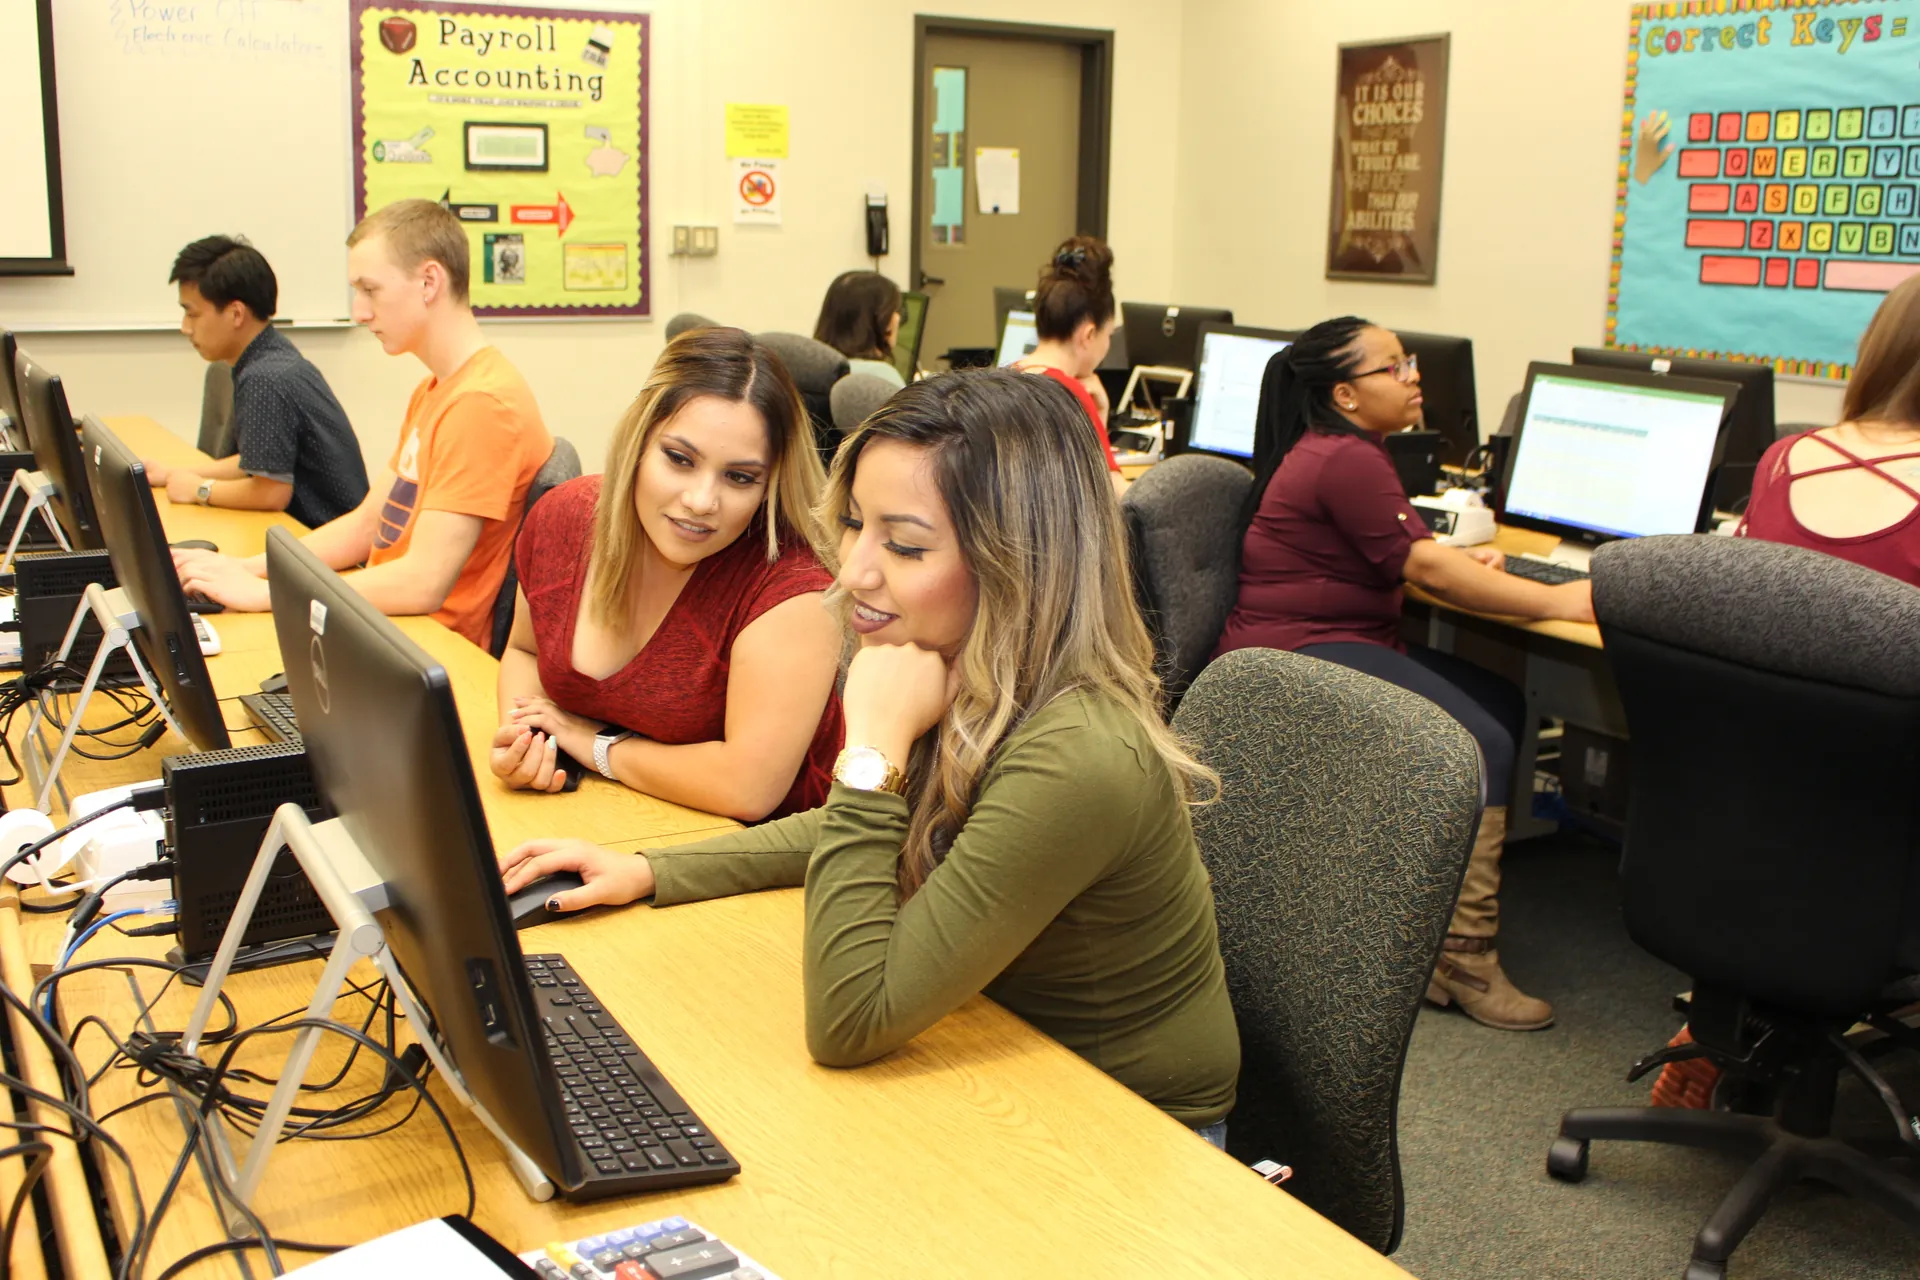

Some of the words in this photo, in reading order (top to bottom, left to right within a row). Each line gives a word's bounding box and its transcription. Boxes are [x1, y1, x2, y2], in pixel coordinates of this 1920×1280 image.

[439, 19, 556, 56] Payroll
[1645, 15, 1772, 57] Correct
[1791, 12, 1882, 55] Keys
[408, 58, 604, 101] Accounting
[1355, 84, 1369, 101] IT
[1373, 84, 1388, 101] IS
[1392, 81, 1424, 101] OUR
[1353, 101, 1424, 126] CHOICES
[1730, 154, 1743, 171] Q
[1757, 155, 1773, 171] W
[1789, 155, 1801, 172] E
[1819, 154, 1830, 171] R
[1850, 154, 1862, 172] T
[1884, 152, 1895, 170] Y
[1741, 190, 1753, 206] A
[1771, 191, 1782, 208] S
[1801, 192, 1813, 208] D
[1833, 192, 1844, 208] F
[1861, 191, 1875, 210] G
[1895, 193, 1907, 209] H
[1345, 210, 1416, 232] ABILITIES
[1757, 227, 1768, 244] Z
[1785, 229, 1796, 245] X
[1814, 229, 1827, 246] C
[1845, 230, 1857, 246] V
[1875, 231, 1887, 248] B
